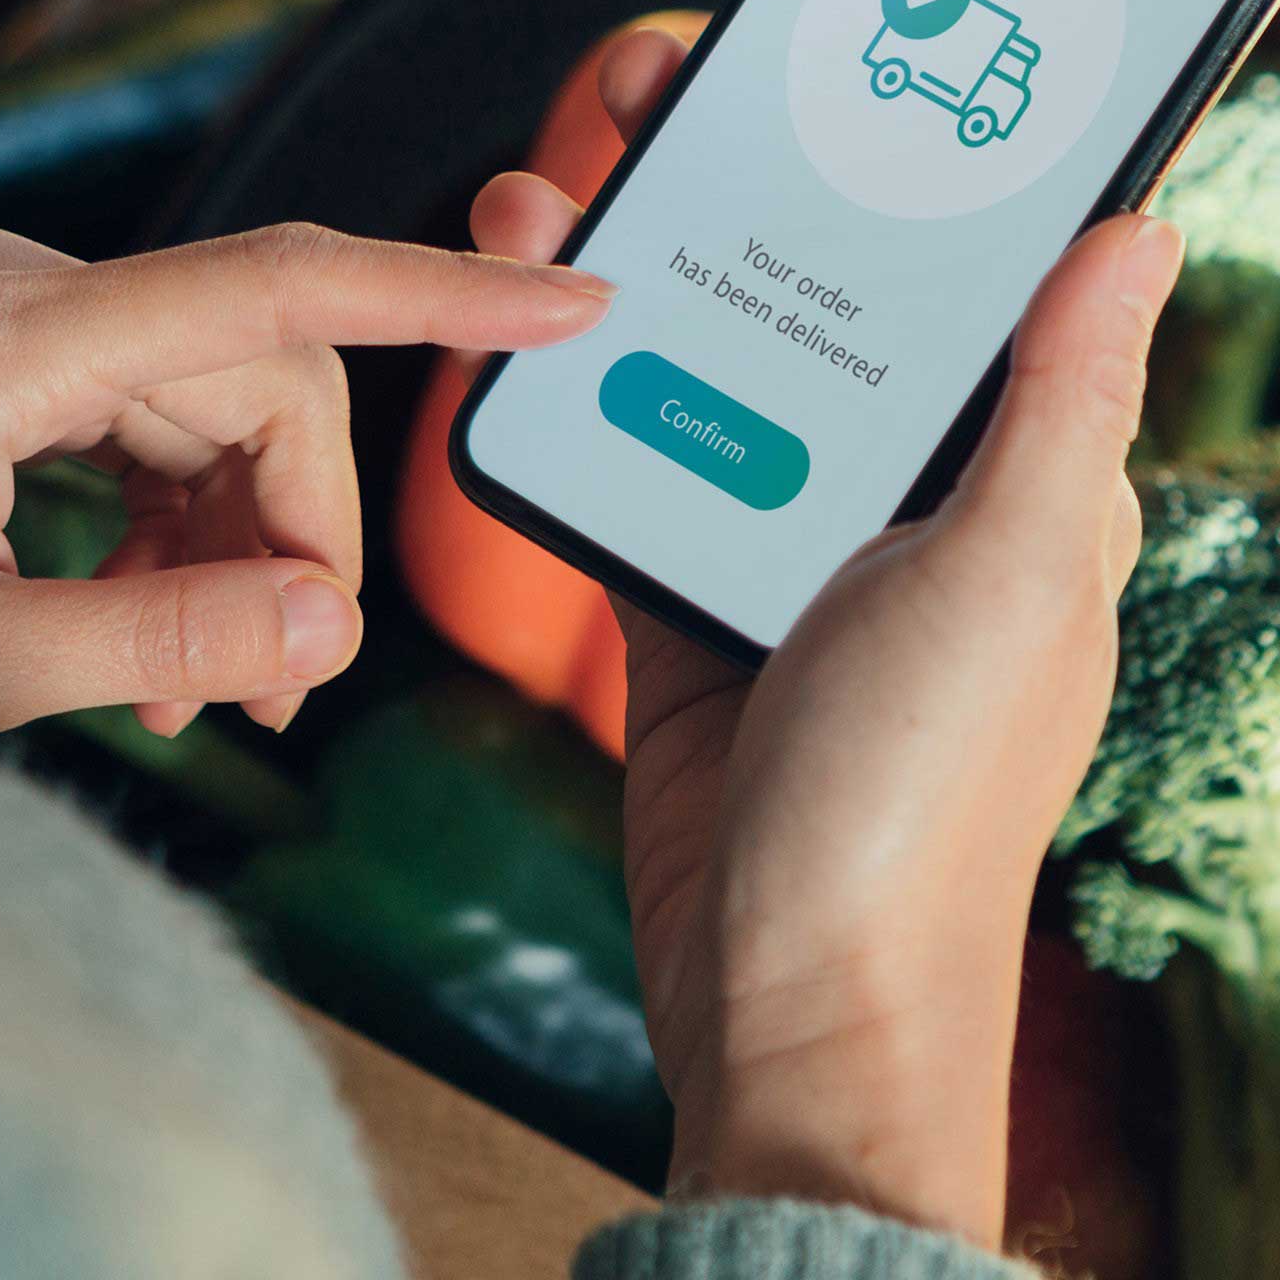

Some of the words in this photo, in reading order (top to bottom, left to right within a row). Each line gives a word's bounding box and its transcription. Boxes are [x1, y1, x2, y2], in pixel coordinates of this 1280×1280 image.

[668, 246, 712, 287] has
[712, 272, 773, 323] been
[775, 313, 889, 387] delivered
[742, 236, 796, 284] Your
[796, 277, 863, 322] order
[659, 399, 746, 464] Confirm
